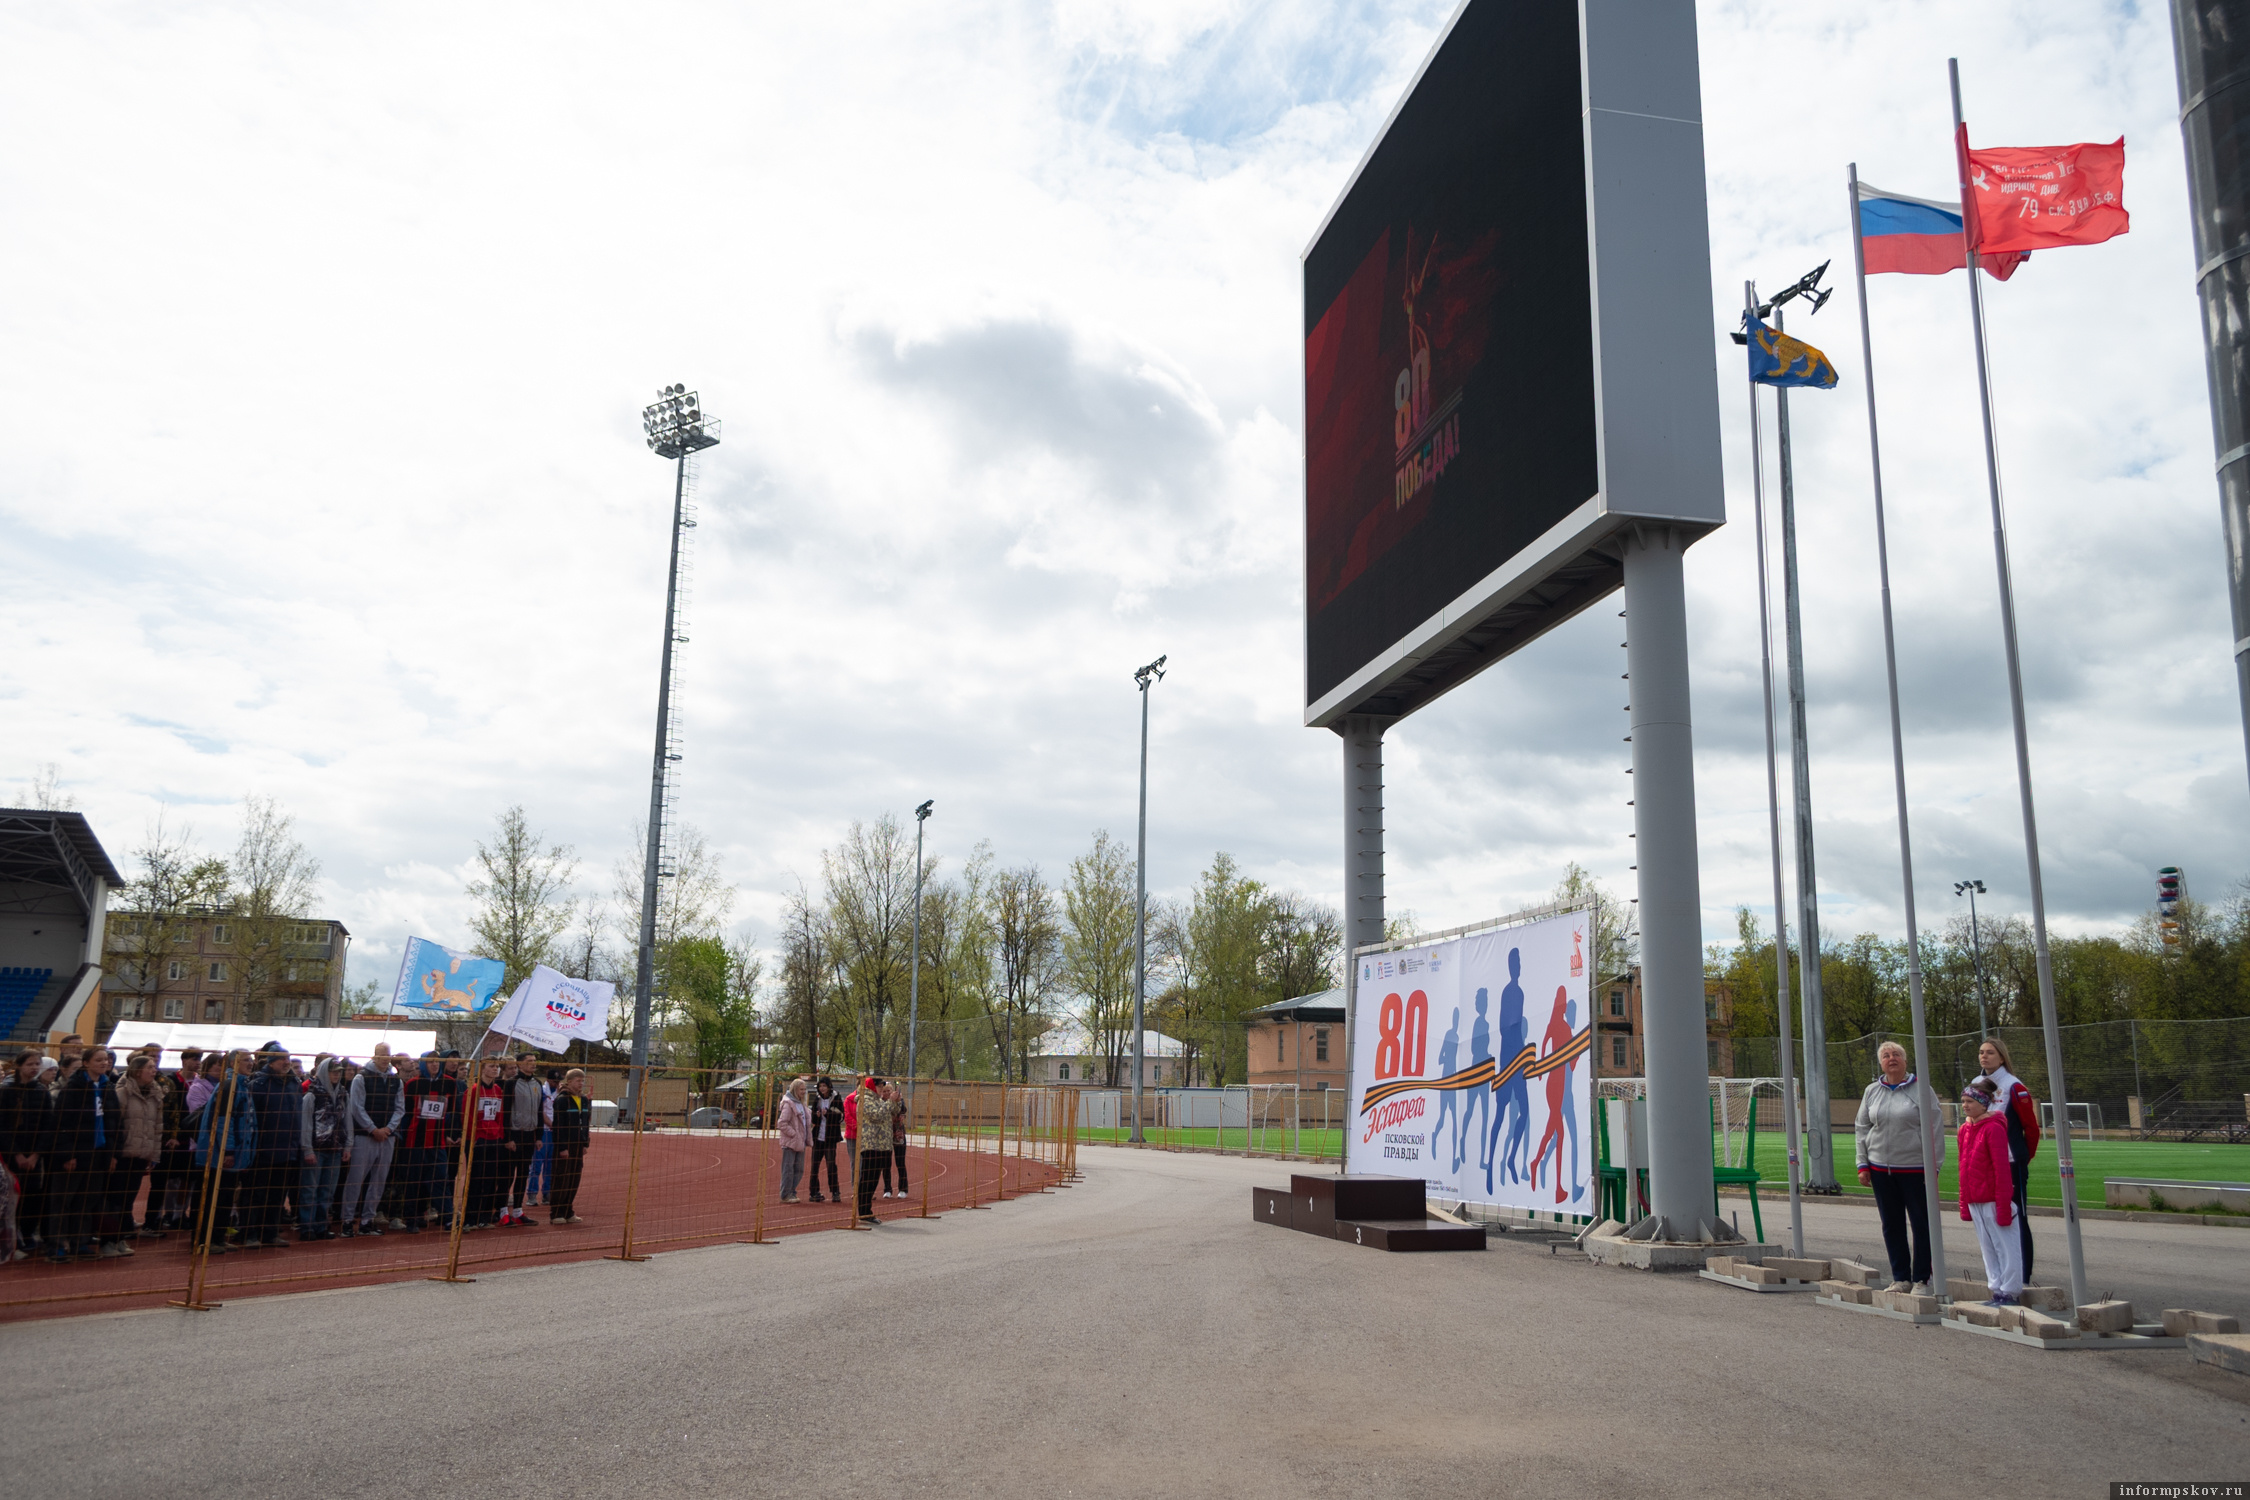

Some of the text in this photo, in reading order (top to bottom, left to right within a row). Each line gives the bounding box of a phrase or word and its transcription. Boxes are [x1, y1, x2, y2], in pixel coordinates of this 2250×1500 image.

[2019, 197, 2039, 218] 79
[1395, 348, 1430, 450] 80
[1396, 412, 1460, 512] ПОБЕДА!
[1374, 989, 1429, 1081] 80
[428, 1103, 441, 1113] 18
[1363, 1095, 1426, 1144] Эстафета
[1384, 1132, 1425, 1145] ПСКОВСКОЙ
[1383, 1146, 1420, 1162] ПРАВДЫ
[1270, 1200, 1275, 1214] 2
[1309, 1197, 1313, 1212] 1
[1356, 1227, 1361, 1244] 3
